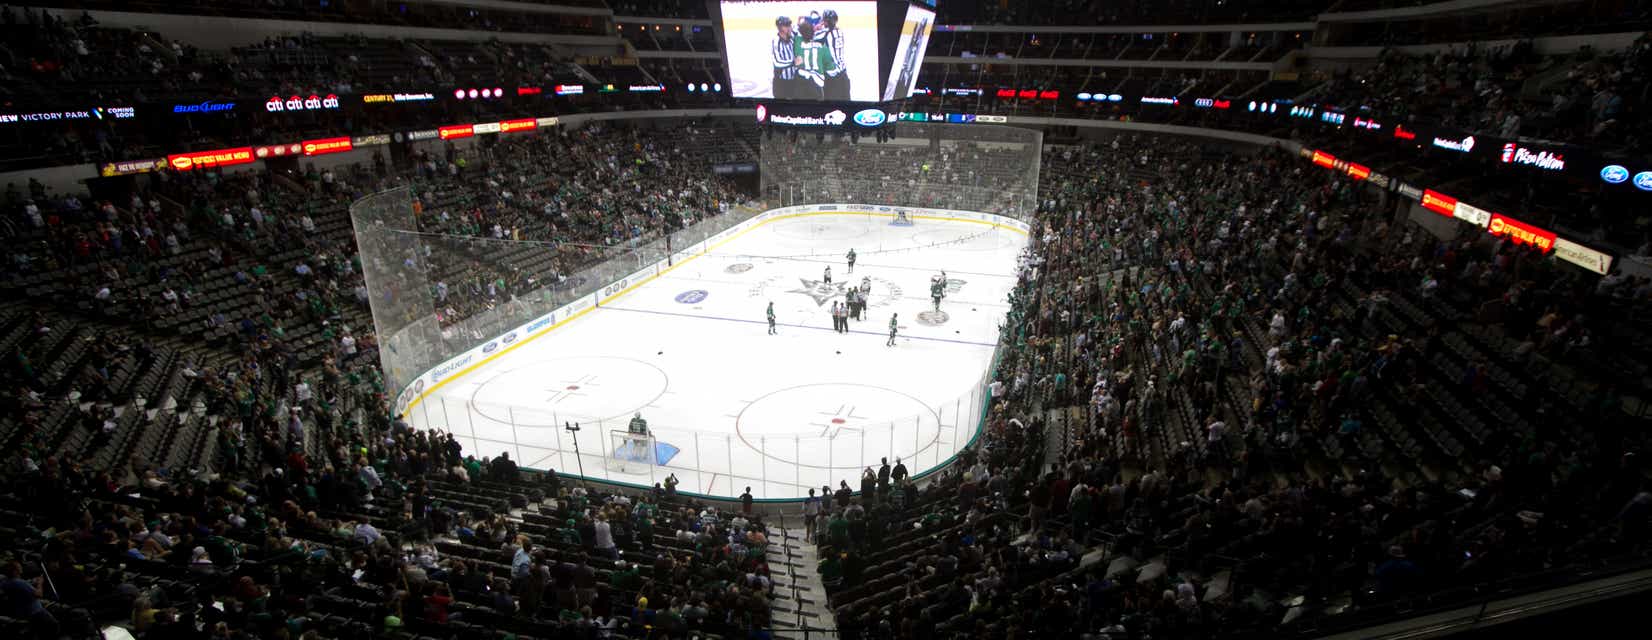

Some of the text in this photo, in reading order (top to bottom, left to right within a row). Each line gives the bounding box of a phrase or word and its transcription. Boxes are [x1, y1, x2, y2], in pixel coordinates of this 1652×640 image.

[803, 47, 820, 71] 11
[173, 102, 236, 113] BUD LIGHT
[265, 97, 339, 112] citi citi citi citi
[20, 112, 63, 121] VICTORY
[65, 111, 90, 119] PARK
[1513, 148, 1537, 163] Pizza
